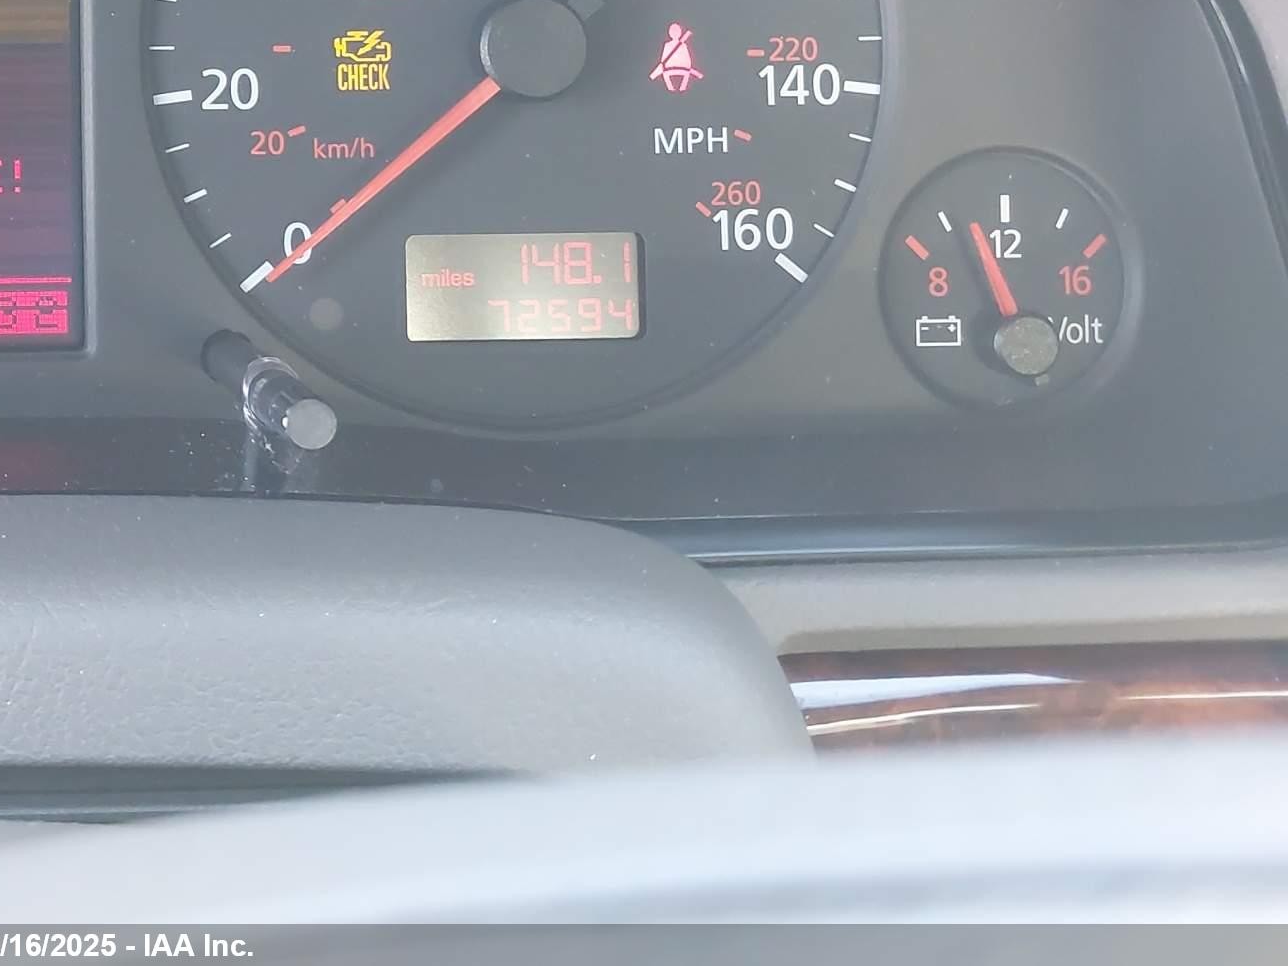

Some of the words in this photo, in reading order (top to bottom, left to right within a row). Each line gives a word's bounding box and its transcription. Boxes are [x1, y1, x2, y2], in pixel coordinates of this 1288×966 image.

[767, 36, 819, 63] 220
[199, 68, 260, 111] 20
[336, 62, 391, 92] CHECK
[757, 62, 842, 107] 140
[249, 130, 285, 156] 20
[313, 137, 376, 161] km/h
[653, 126, 729, 155] MPH
[710, 180, 762, 206] 260
[283, 222, 313, 264] 0
[711, 209, 794, 252] 160
[989, 229, 1022, 259] 12
[520, 241, 632, 285] 148.1
[420, 269, 476, 288] miles
[928, 267, 949, 297] 8
[1059, 266, 1092, 296] 16
[487, 297, 634, 333] 72594
